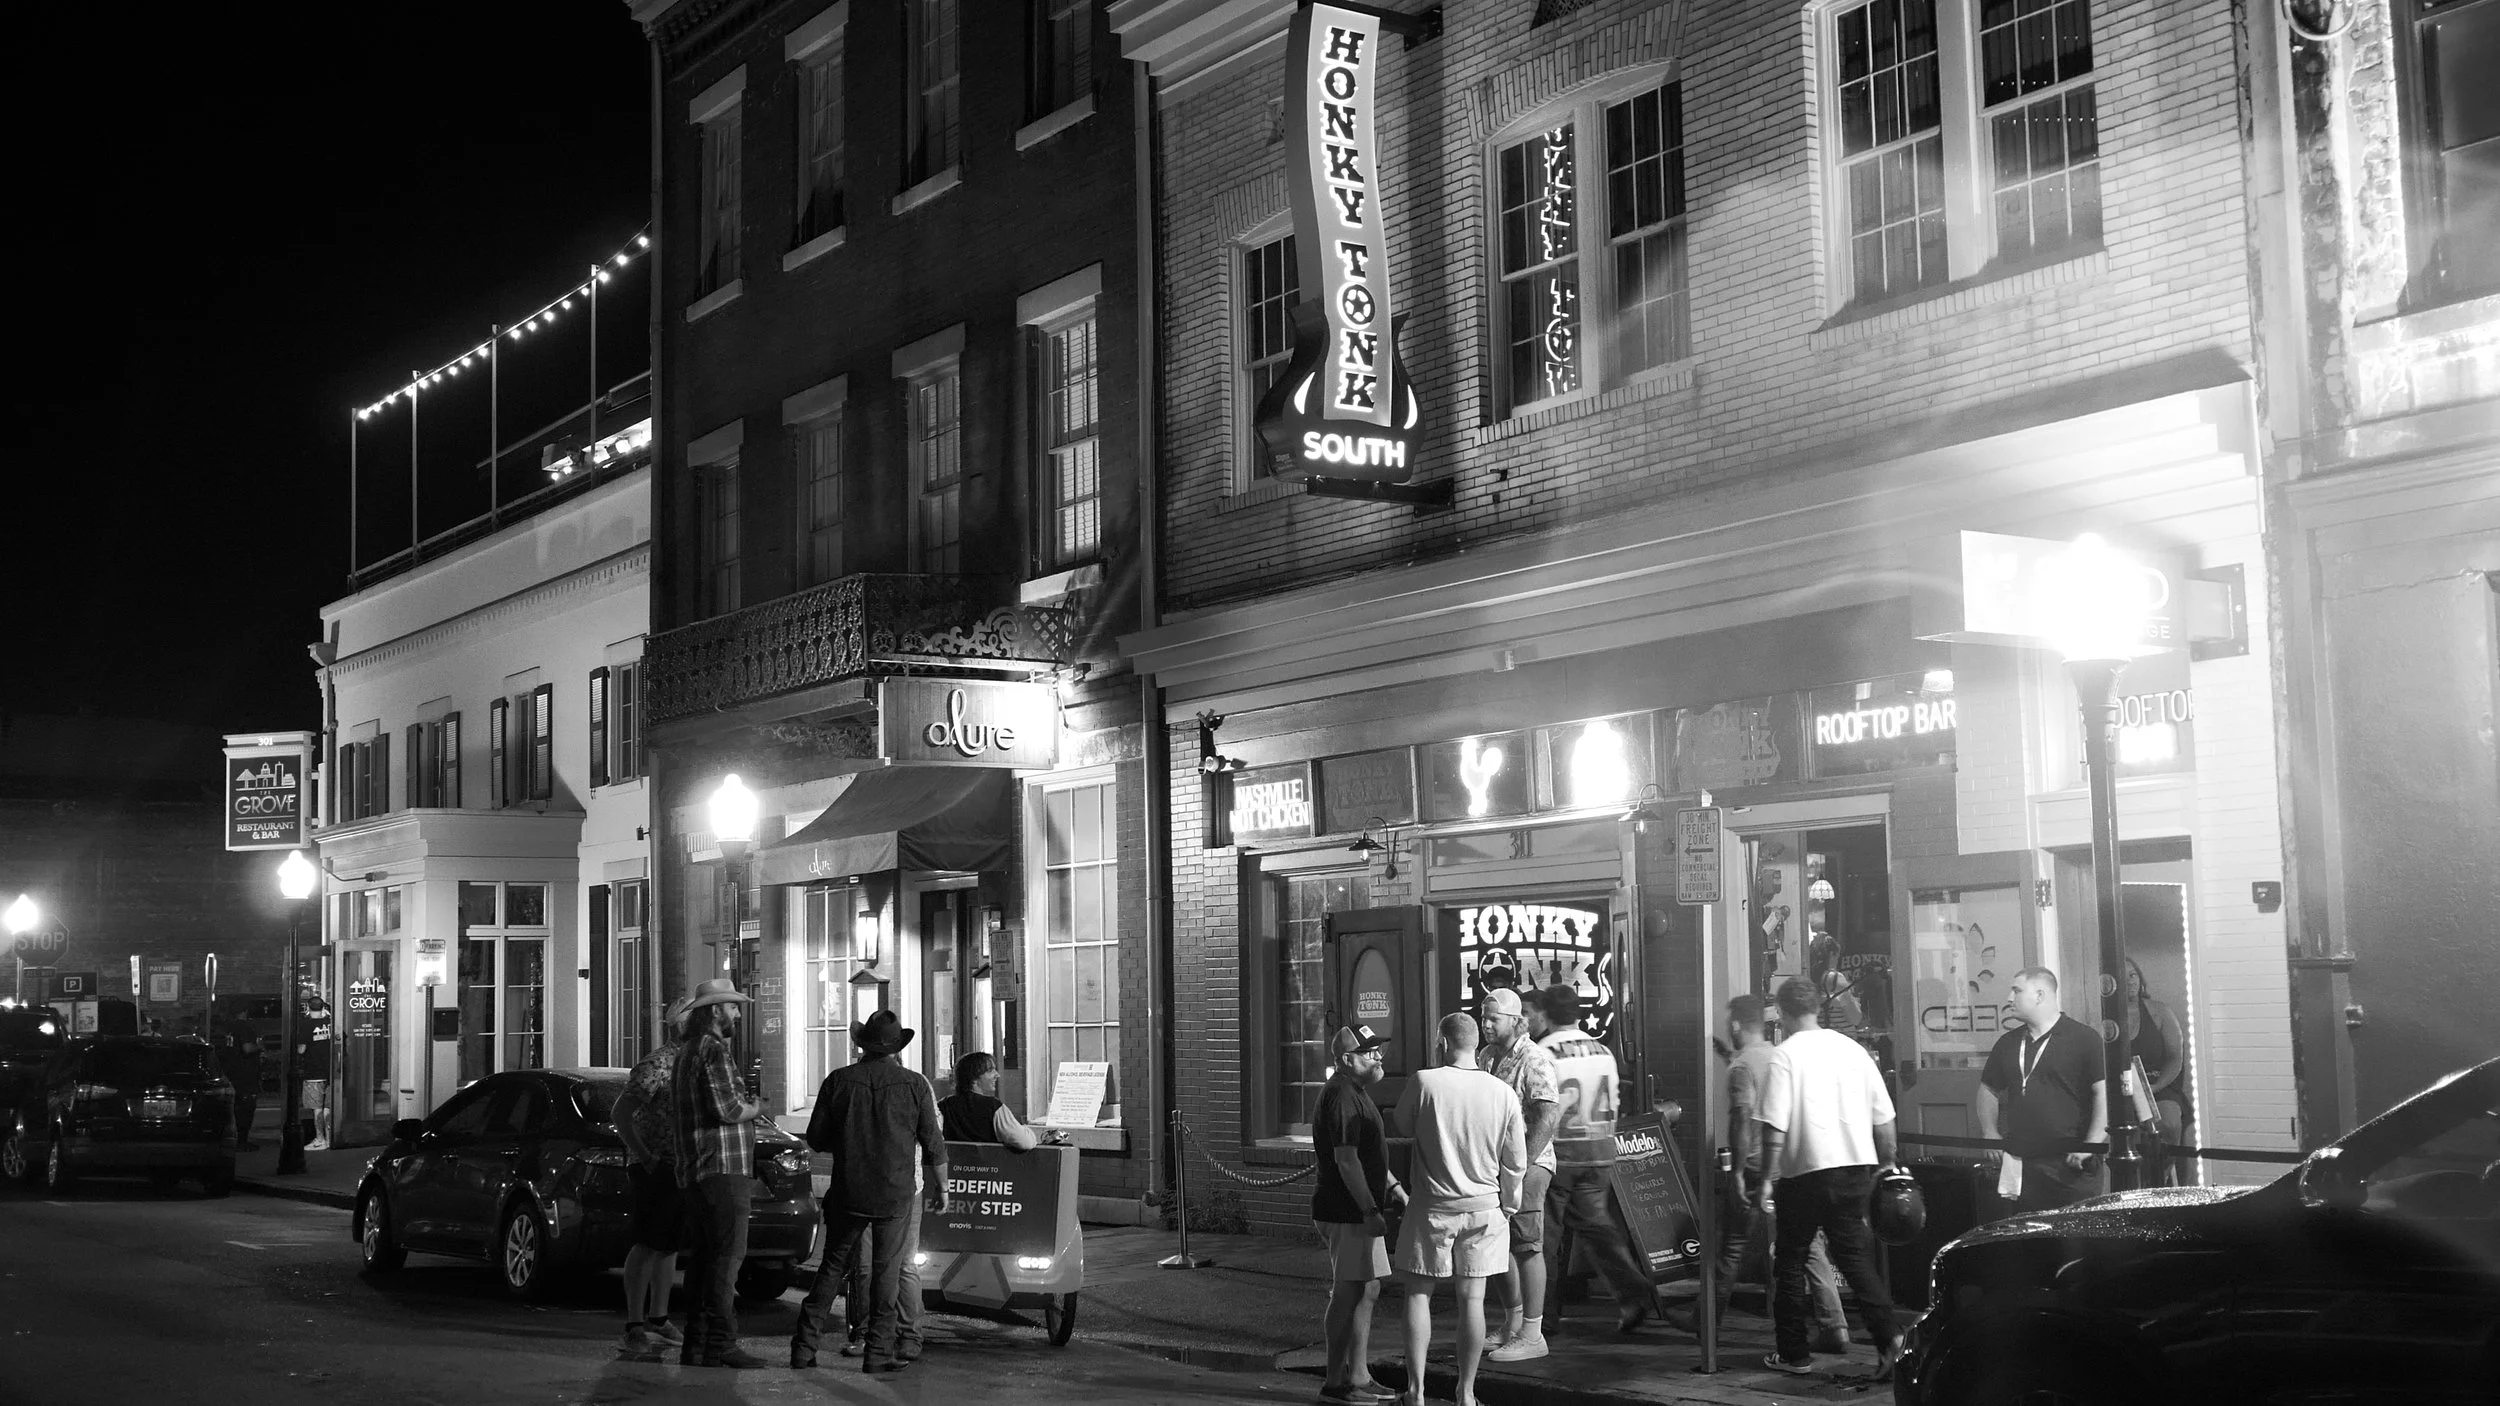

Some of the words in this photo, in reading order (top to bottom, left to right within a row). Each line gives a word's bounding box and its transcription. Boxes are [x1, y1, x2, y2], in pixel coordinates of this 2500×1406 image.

[1319, 25, 1365, 229] HONKY
[1334, 239, 1379, 413] TONK
[1303, 430, 1406, 468] SOUTH
[1816, 705, 1909, 745] ROOFTOP
[1914, 699, 1957, 734] BAR
[258, 737, 273, 746] 301
[1234, 778, 1304, 810] NASHVILLE
[235, 795, 296, 814] GROVE
[1229, 808, 1257, 833] HOT
[1257, 800, 1311, 830] CHICKEN
[1686, 813, 1694, 823] 30
[236, 821, 295, 833] RESTAURANT
[252, 832, 261, 840] &
[262, 831, 280, 839] BAR
[1681, 823, 1716, 835] FREIGHT
[1509, 830, 1533, 860] 311
[1688, 834, 1710, 845] ZONE
[18, 931, 65, 951] STOP
[69, 980, 77, 988] P
[349, 997, 386, 1009] GROVE
[1359, 991, 1387, 1000] HONKY
[1359, 999, 1388, 1010] TONK
[1558, 1075, 1615, 1138] 24
[1614, 1133, 1655, 1155] Modelo
[948, 1179, 1014, 1195] EDEFINE
[924, 1199, 977, 1214] EERY
[980, 1201, 1022, 1216] STEP
